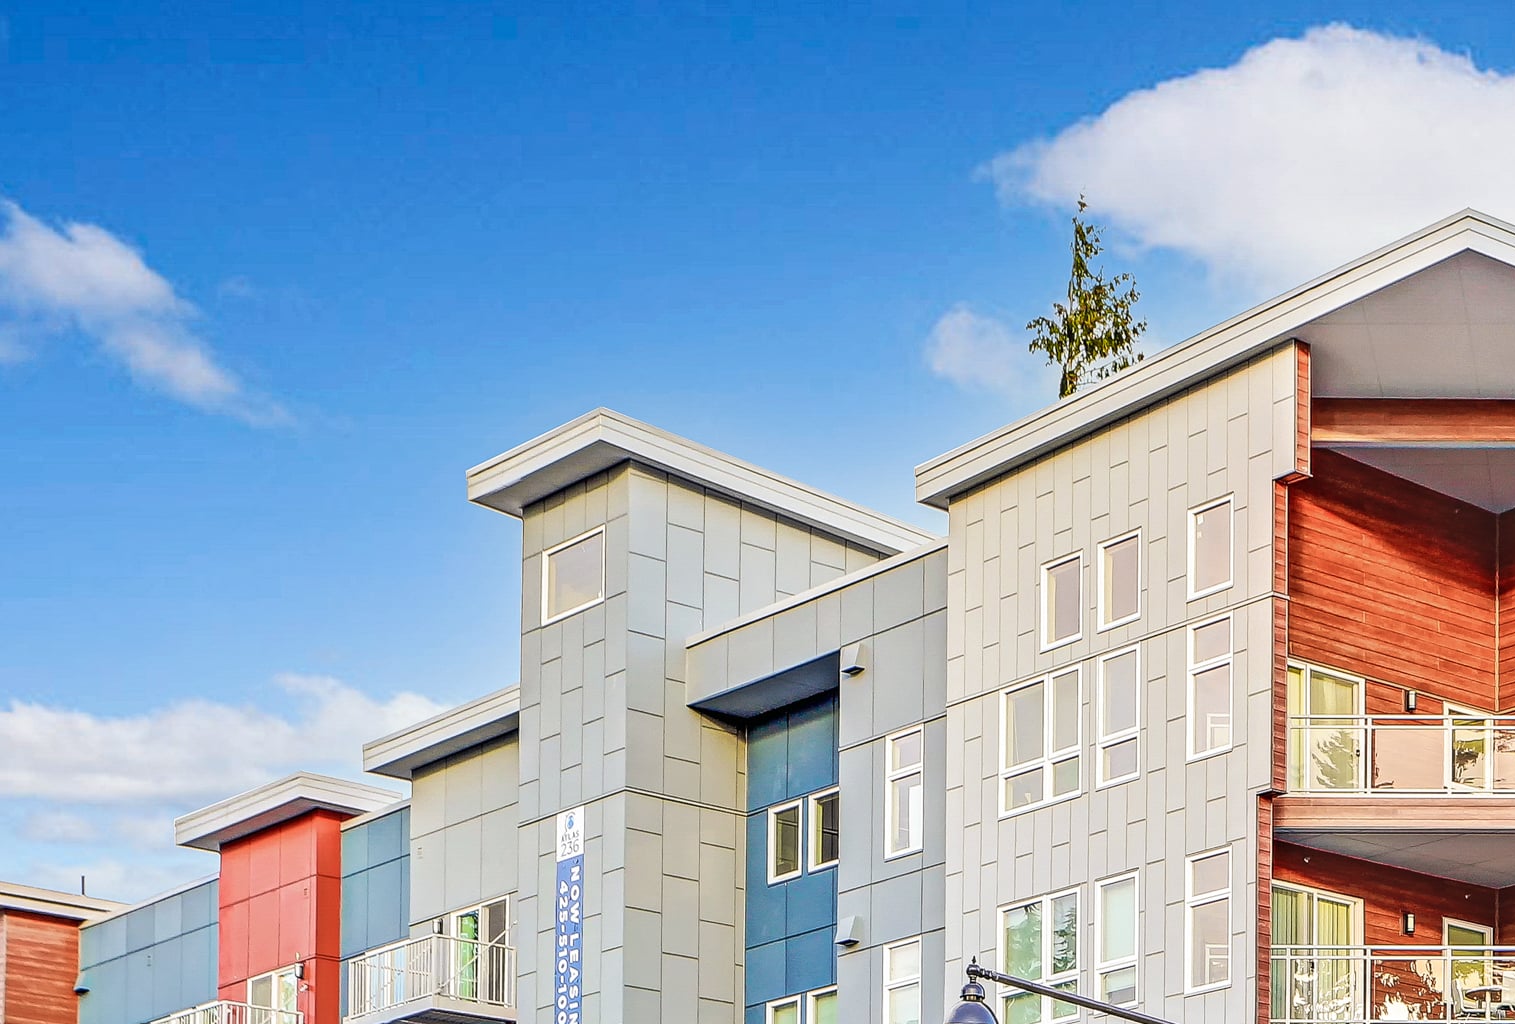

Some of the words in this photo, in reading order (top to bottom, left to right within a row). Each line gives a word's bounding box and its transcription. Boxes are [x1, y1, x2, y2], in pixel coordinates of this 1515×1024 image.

[560, 830, 580, 842] ATLAS
[560, 839, 580, 857] 236
[569, 865, 581, 924] NOW
